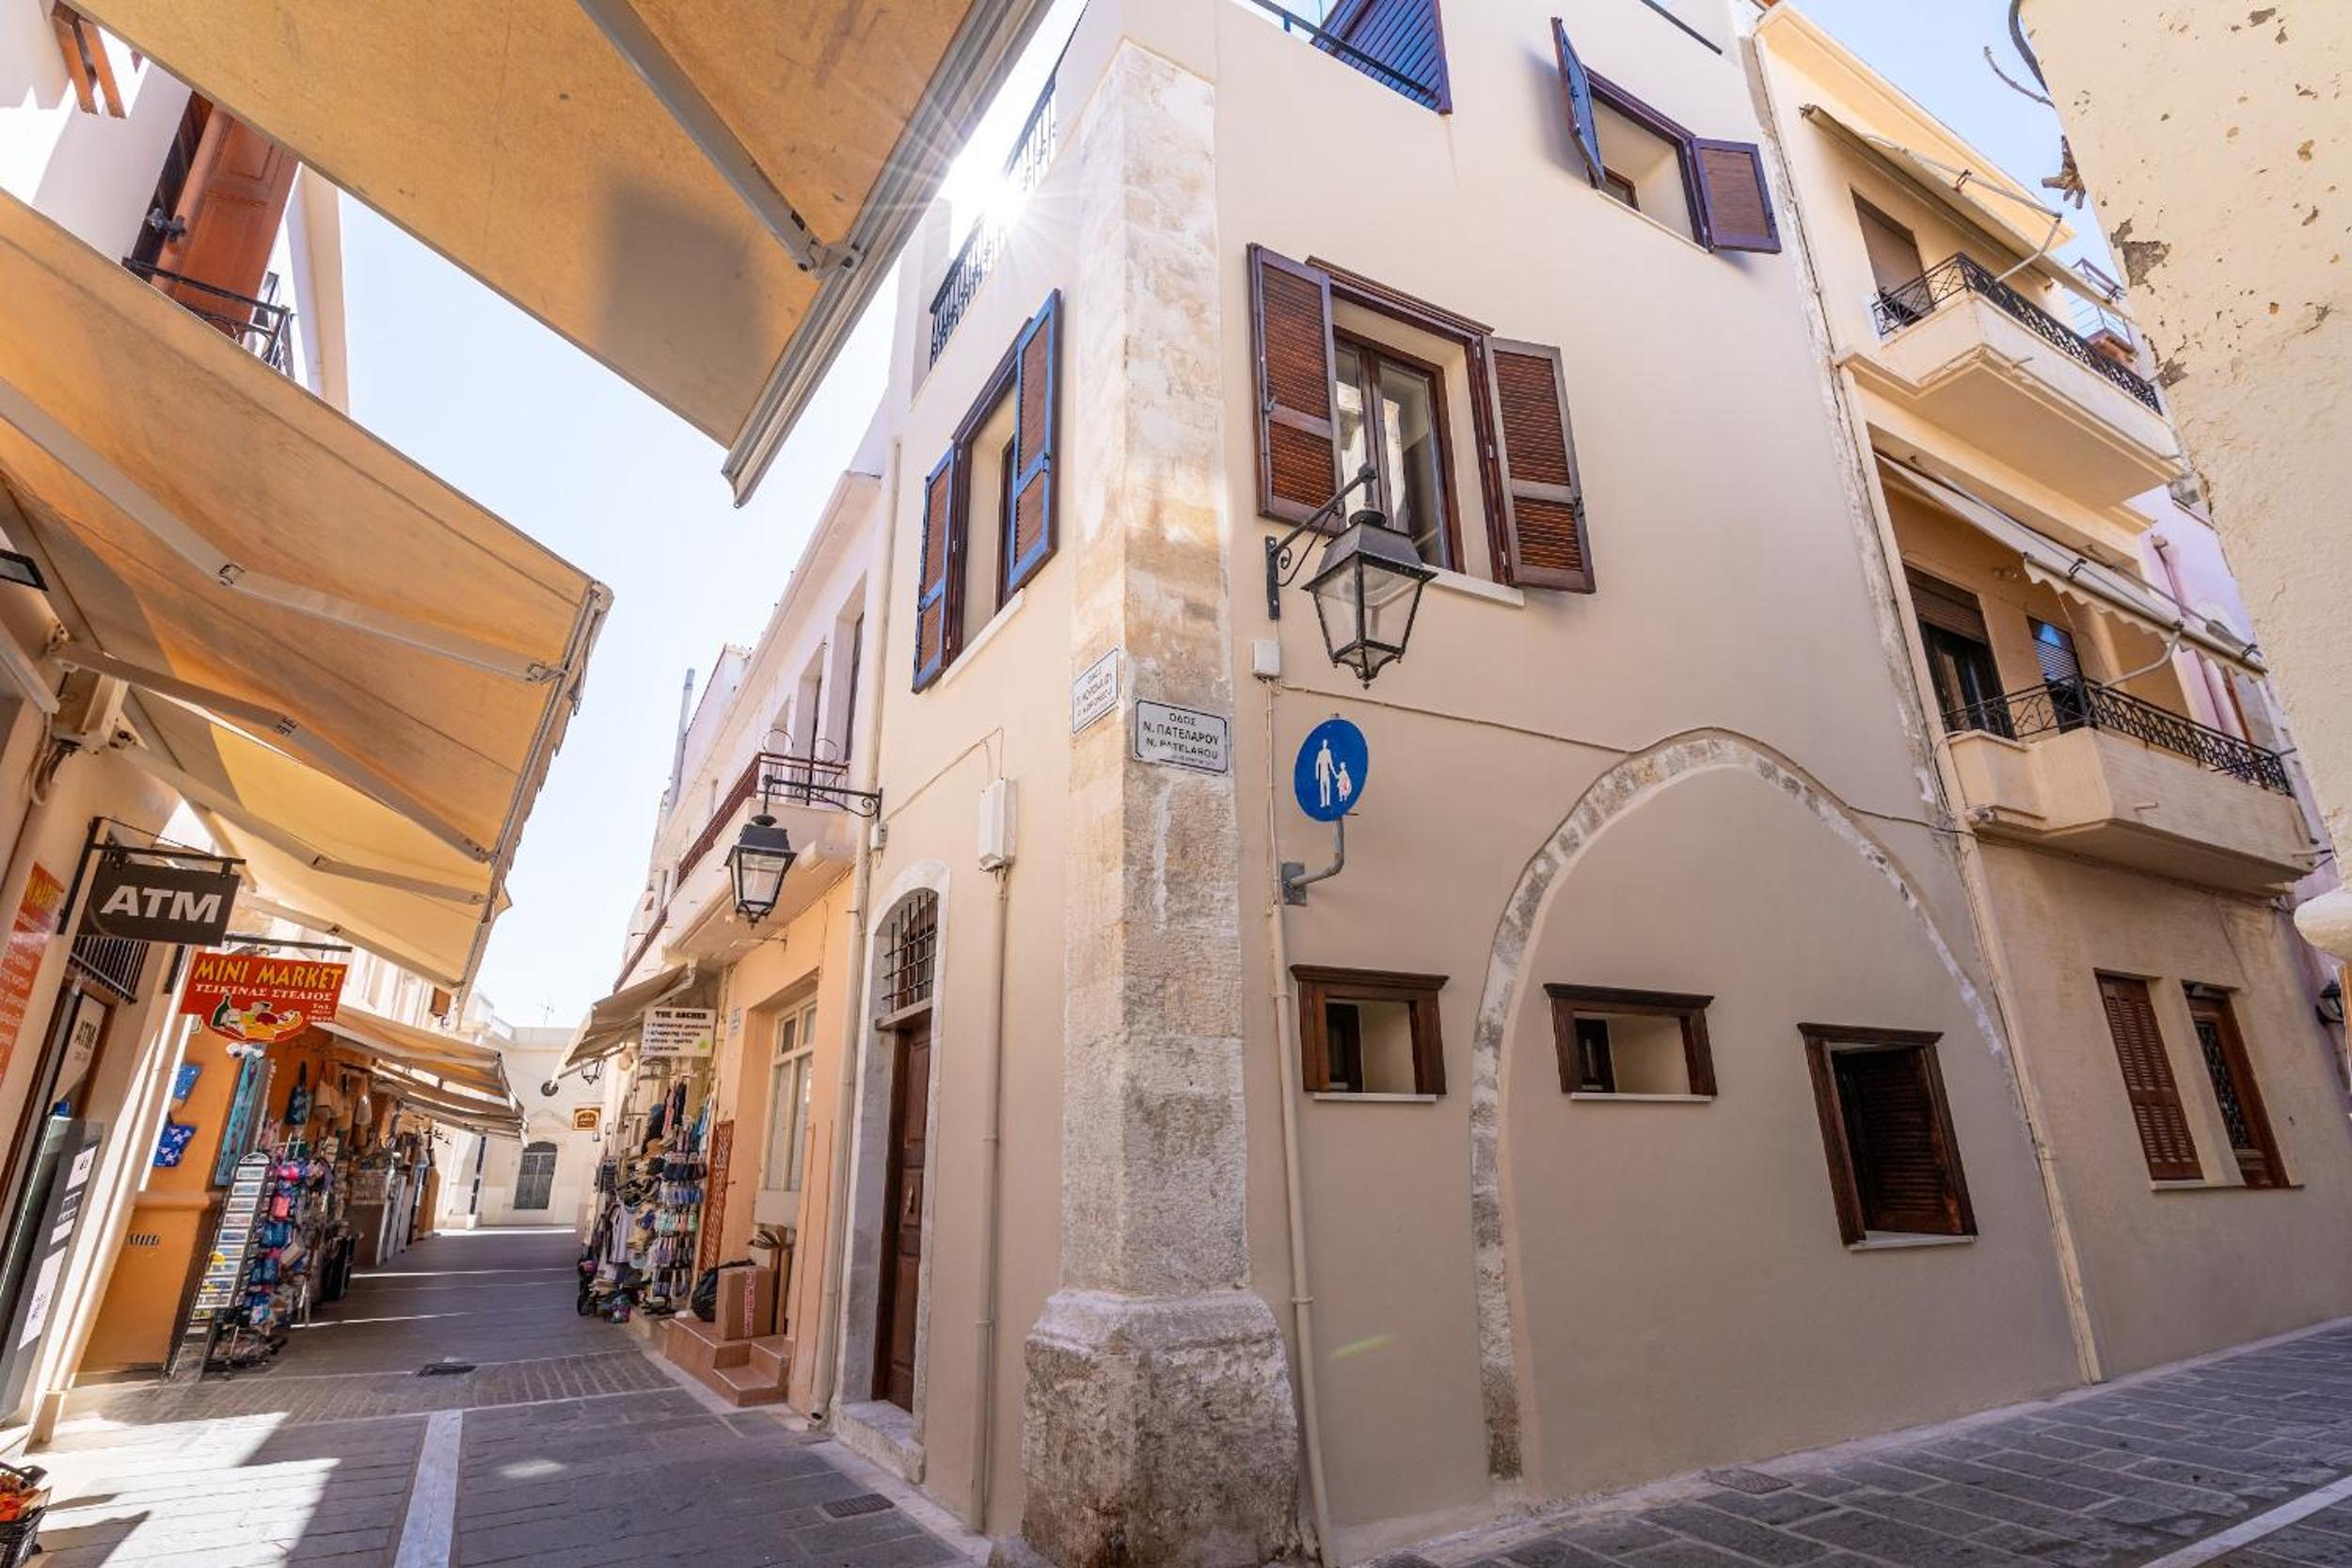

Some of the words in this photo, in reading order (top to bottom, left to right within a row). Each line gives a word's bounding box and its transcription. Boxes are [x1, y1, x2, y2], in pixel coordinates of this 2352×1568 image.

[1169, 713, 1197, 726] ΟΔΟΣ
[1156, 723, 1218, 746] ΠΑΤΕΛΑΡΟΥ
[1159, 739, 1218, 760] PATELAROU
[100, 885, 222, 924] ATM
[194, 958, 249, 984] MINI
[255, 964, 342, 990] MARKET
[195, 984, 268, 997] ΤΣΙΚΙΝΑΣ
[271, 989, 333, 1002] ΣΤΕΛΙΟΣ
[655, 1010, 672, 1019] THE
